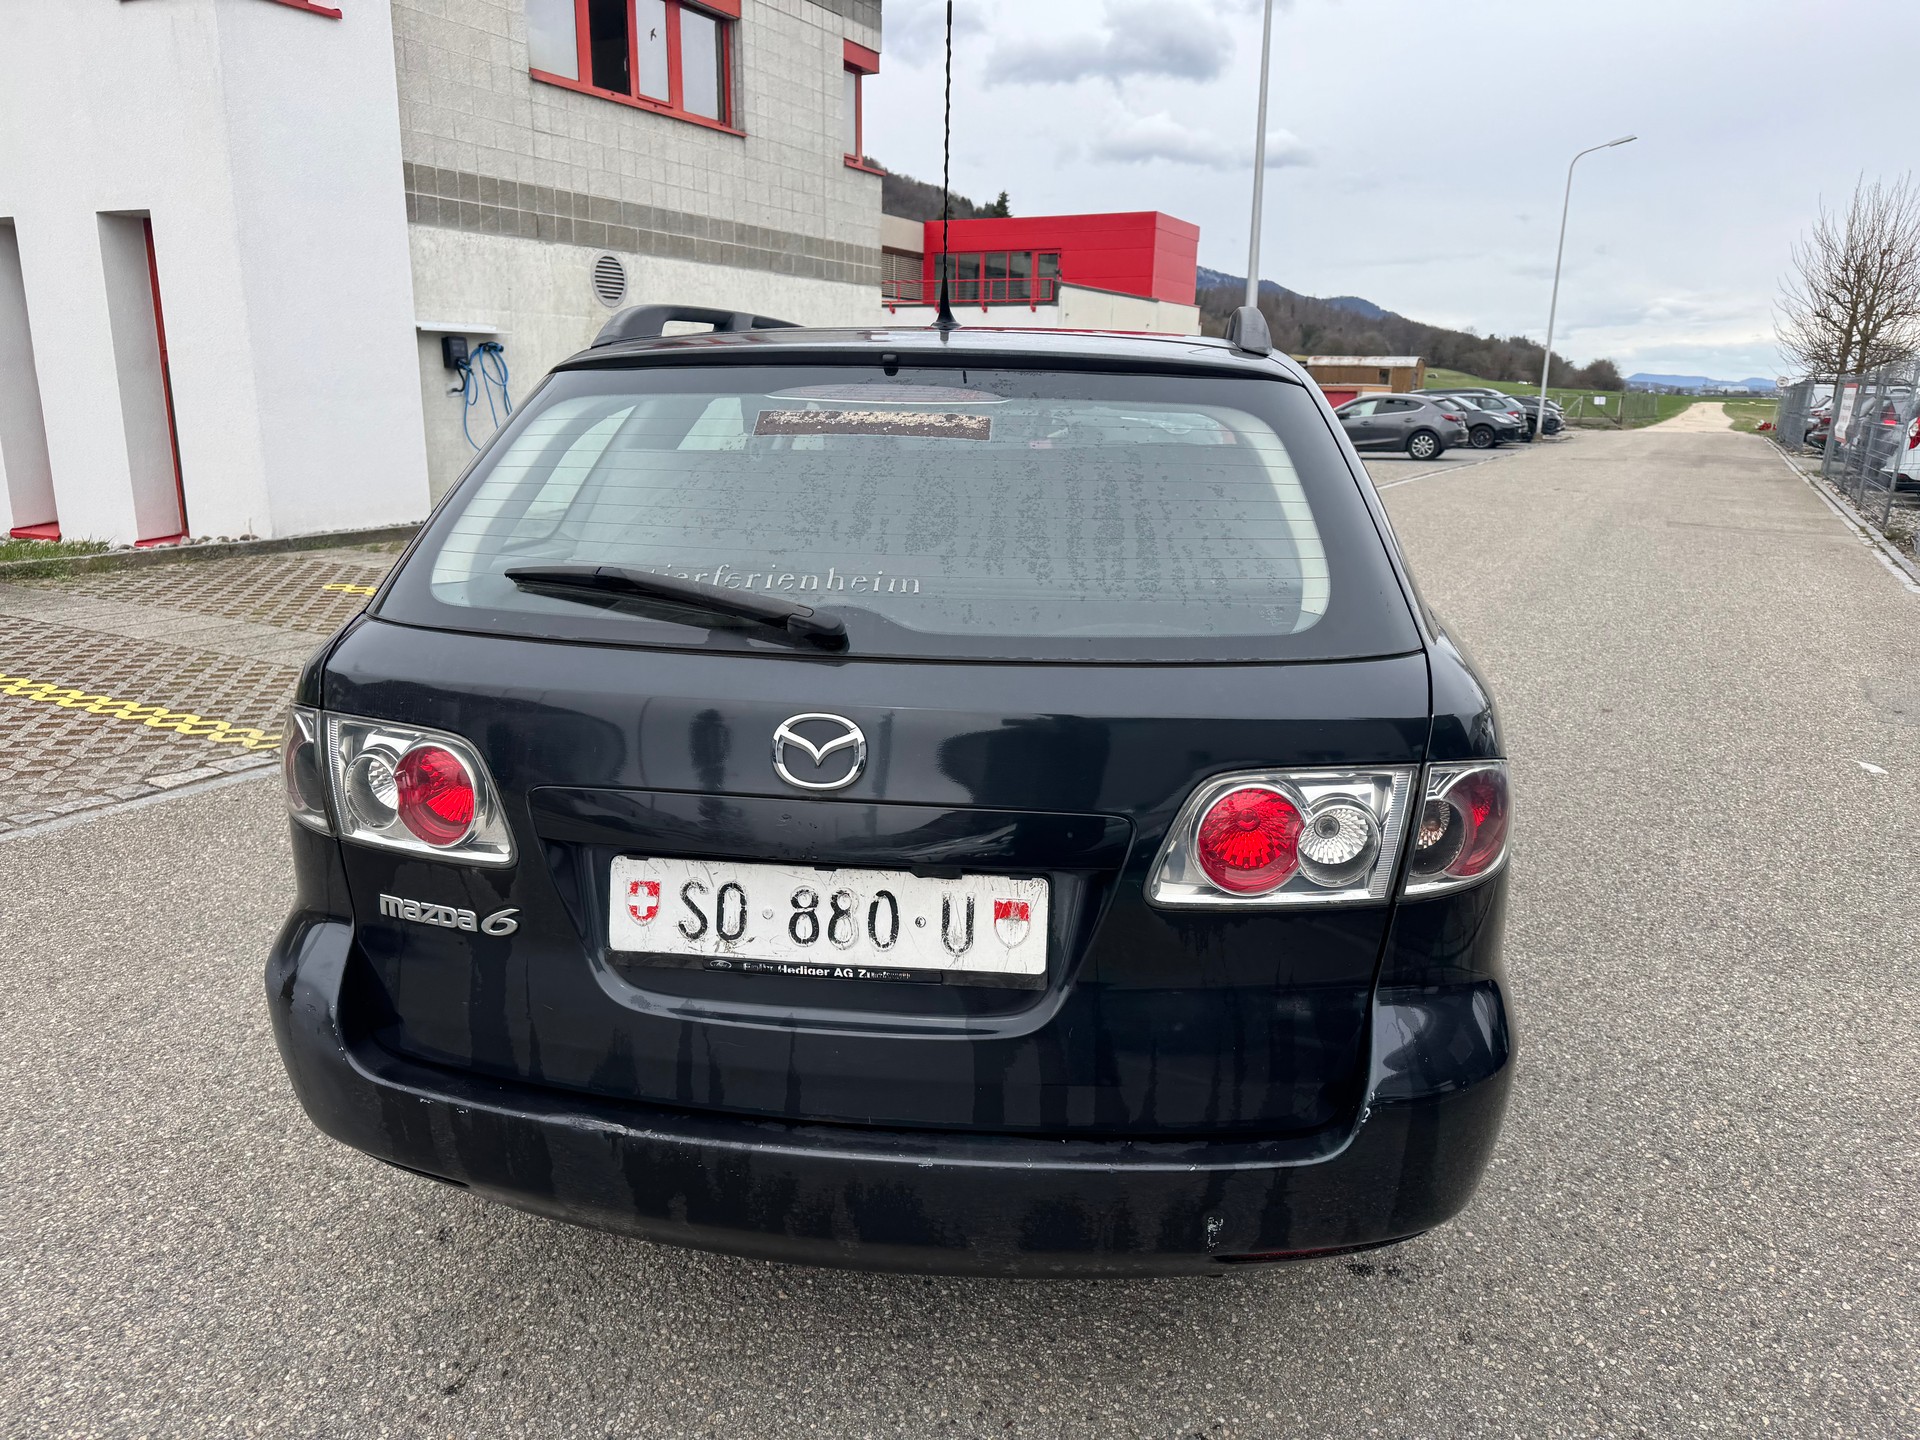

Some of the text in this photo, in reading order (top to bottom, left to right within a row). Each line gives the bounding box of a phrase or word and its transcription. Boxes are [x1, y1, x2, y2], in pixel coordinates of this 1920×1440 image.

[651, 563, 921, 594] erferienheim
[481, 908, 520, 936] 6
[678, 877, 974, 958] SO 880 U
[834, 968, 854, 978] AG
